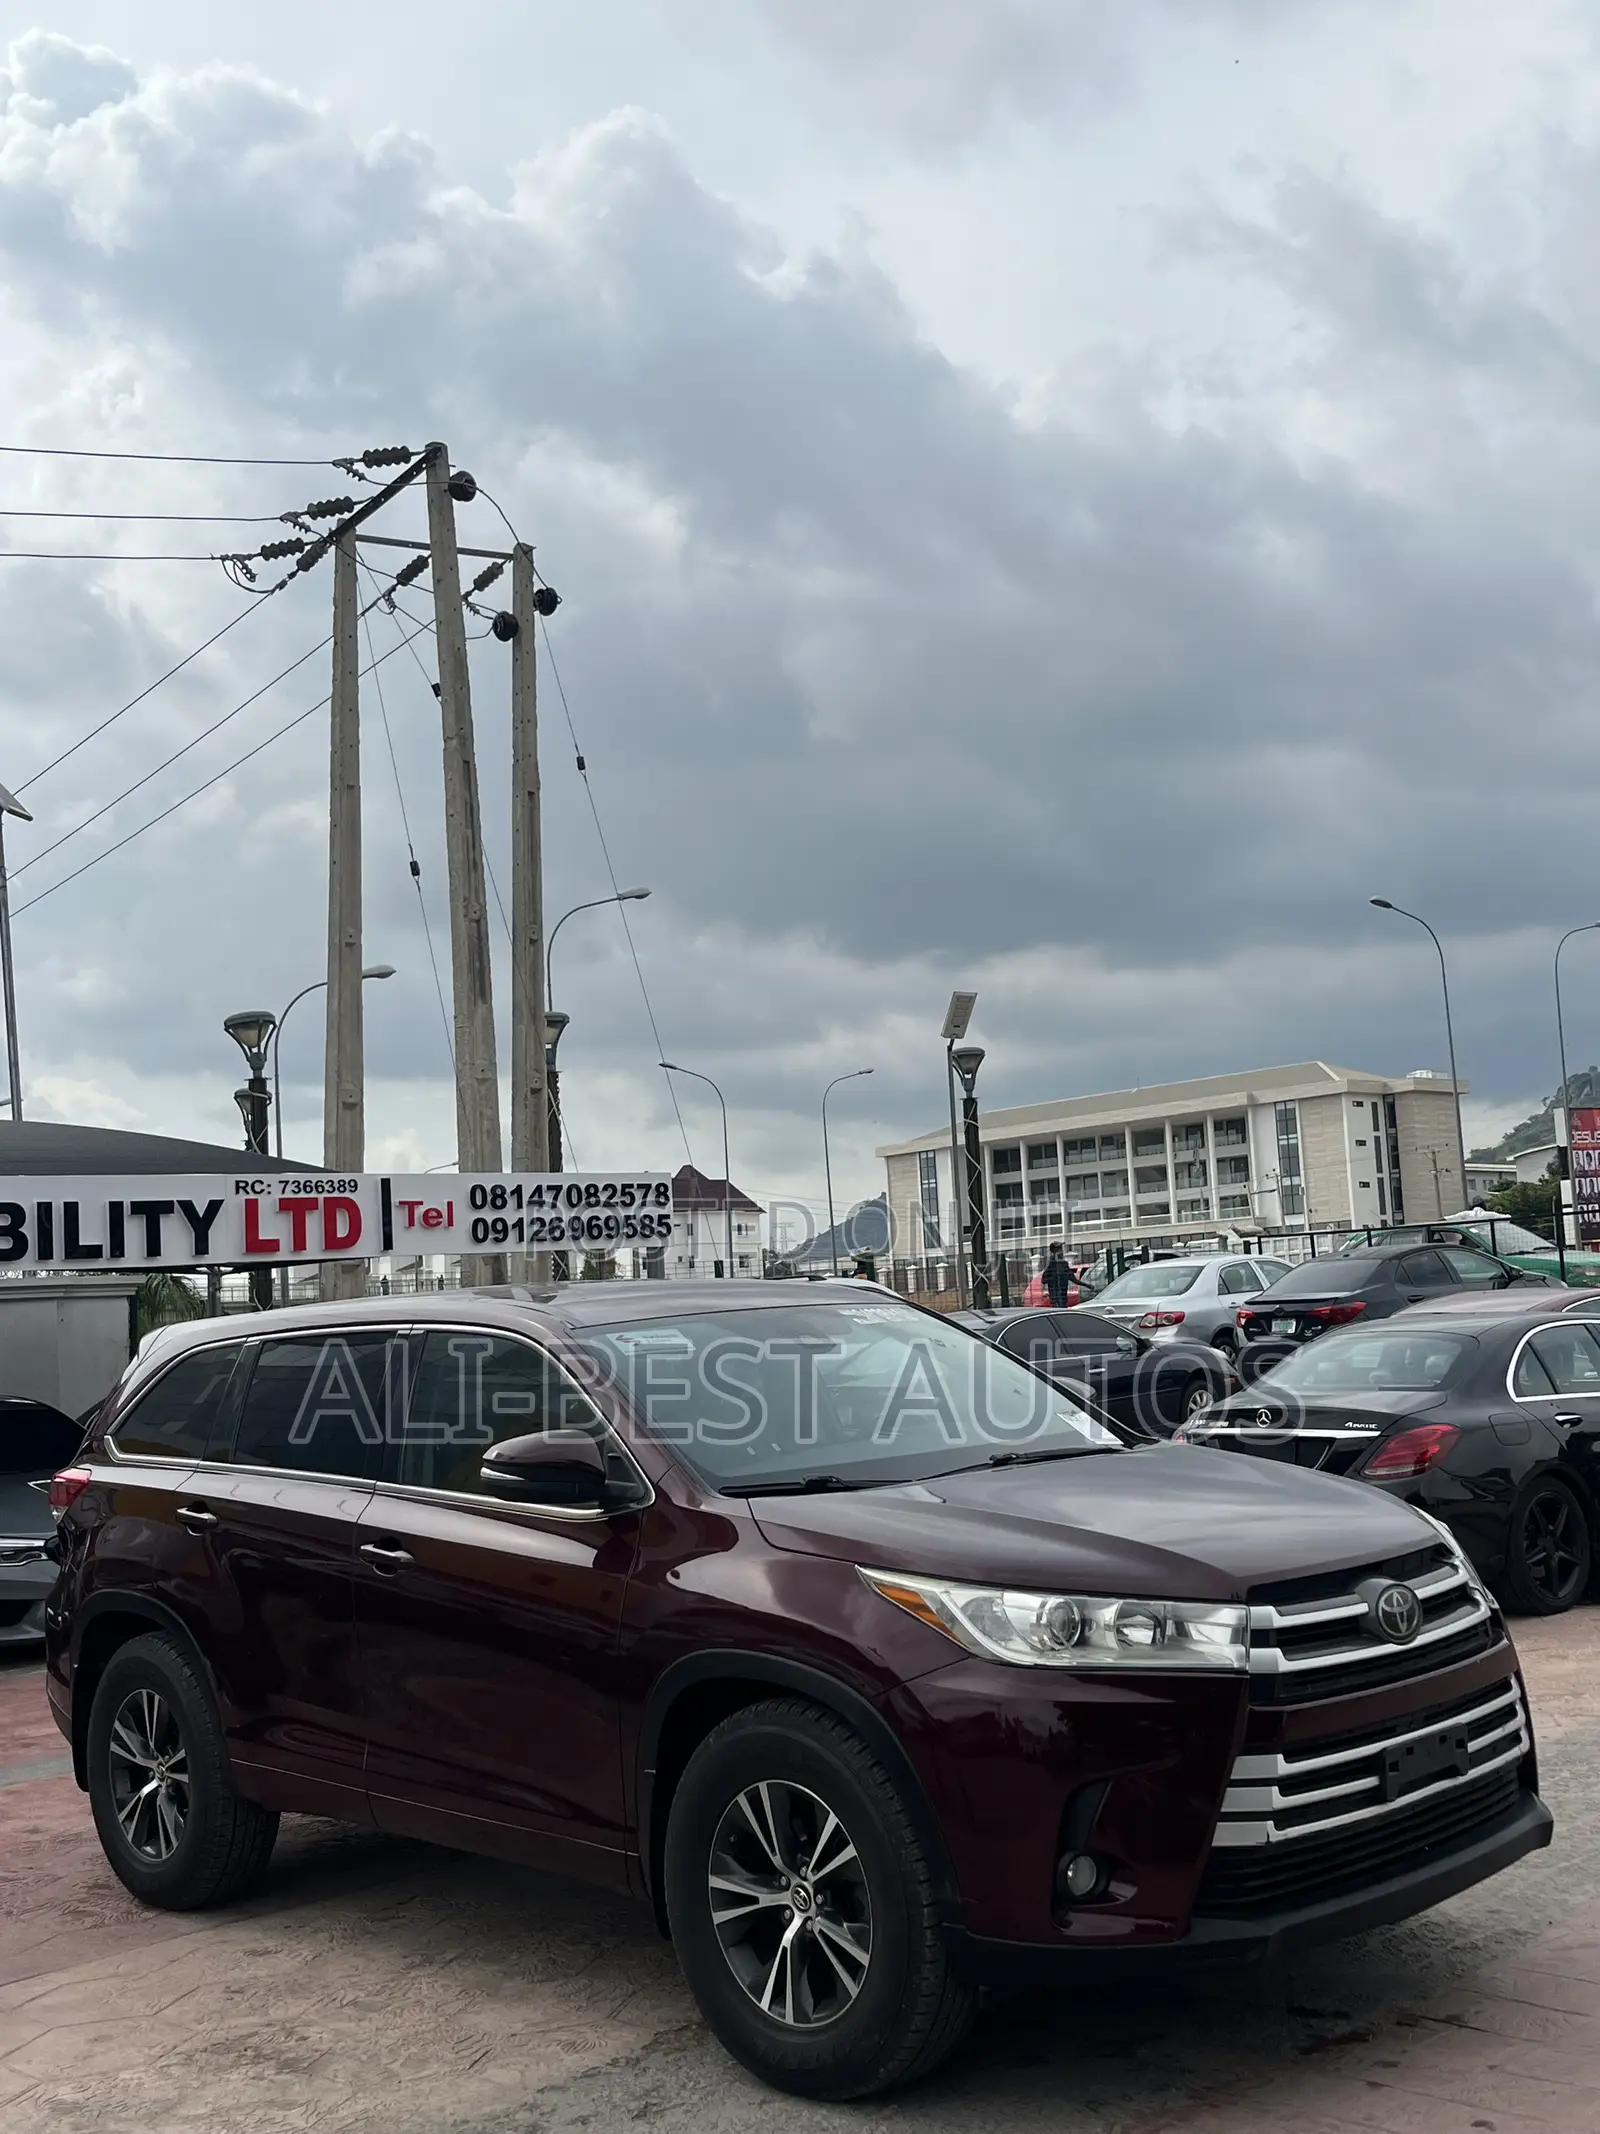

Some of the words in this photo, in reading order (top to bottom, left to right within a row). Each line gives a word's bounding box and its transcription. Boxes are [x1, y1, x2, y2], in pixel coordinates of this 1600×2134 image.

[235, 1180, 272, 1194] RC:
[278, 1179, 358, 1194] 7366389
[469, 1182, 670, 1210] 08147082578
[398, 1201, 454, 1228] Tel
[471, 1213, 672, 1243] 09126969585
[0, 1199, 225, 1261] BILITY
[244, 1197, 362, 1253] LTD
